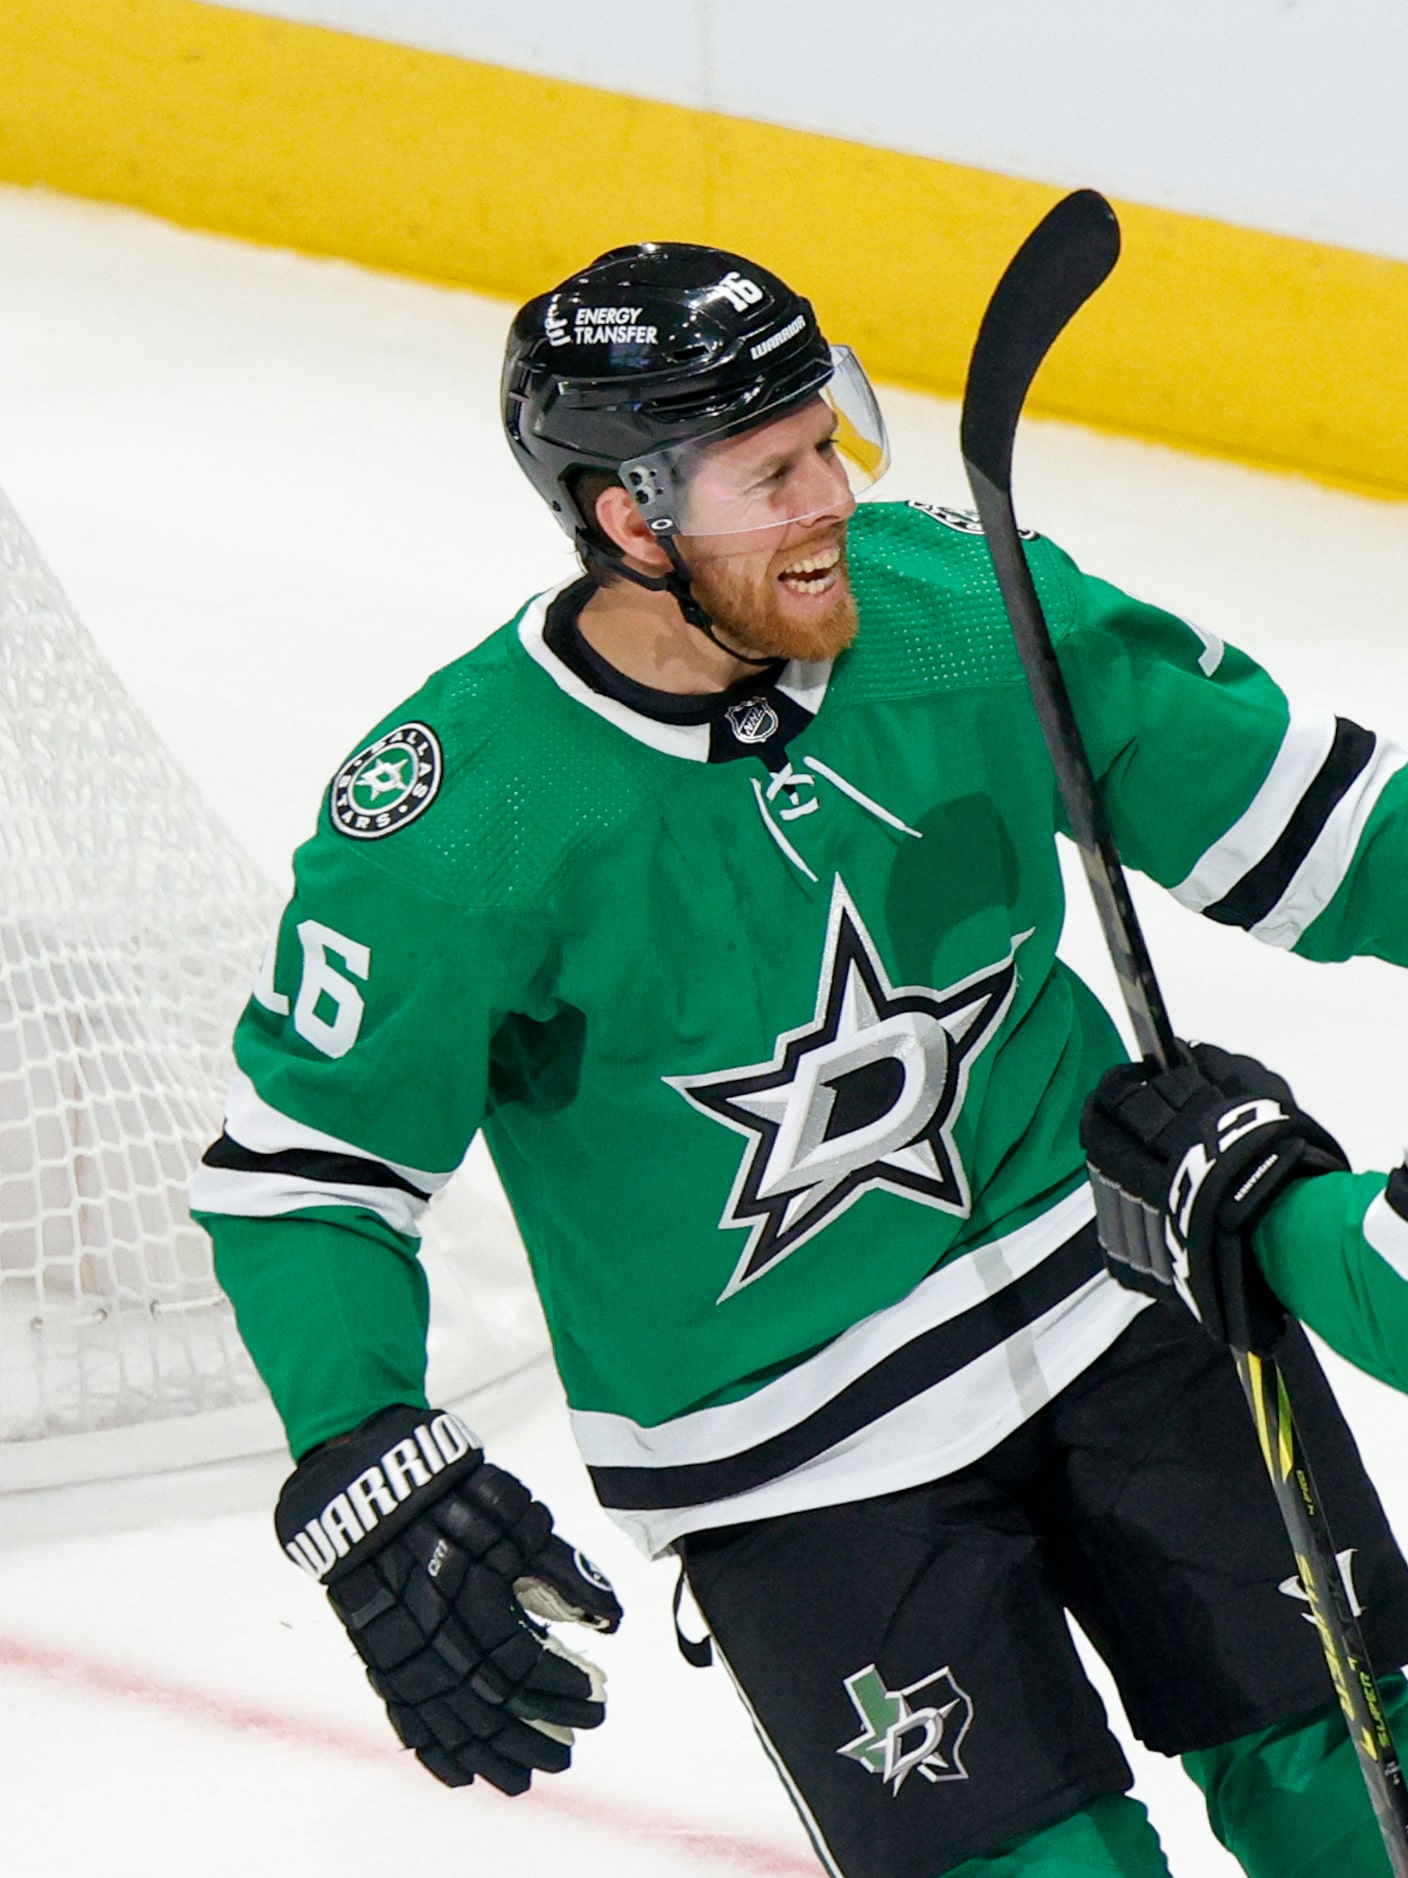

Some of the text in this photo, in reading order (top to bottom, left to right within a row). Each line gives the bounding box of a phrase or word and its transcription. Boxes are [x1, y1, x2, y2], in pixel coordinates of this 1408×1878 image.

[714, 271, 763, 313] 16
[573, 325, 658, 345] TRANSFER
[574, 307, 644, 325] ENERGY
[750, 314, 807, 361] WARRIOR
[253, 918, 372, 1060] 16
